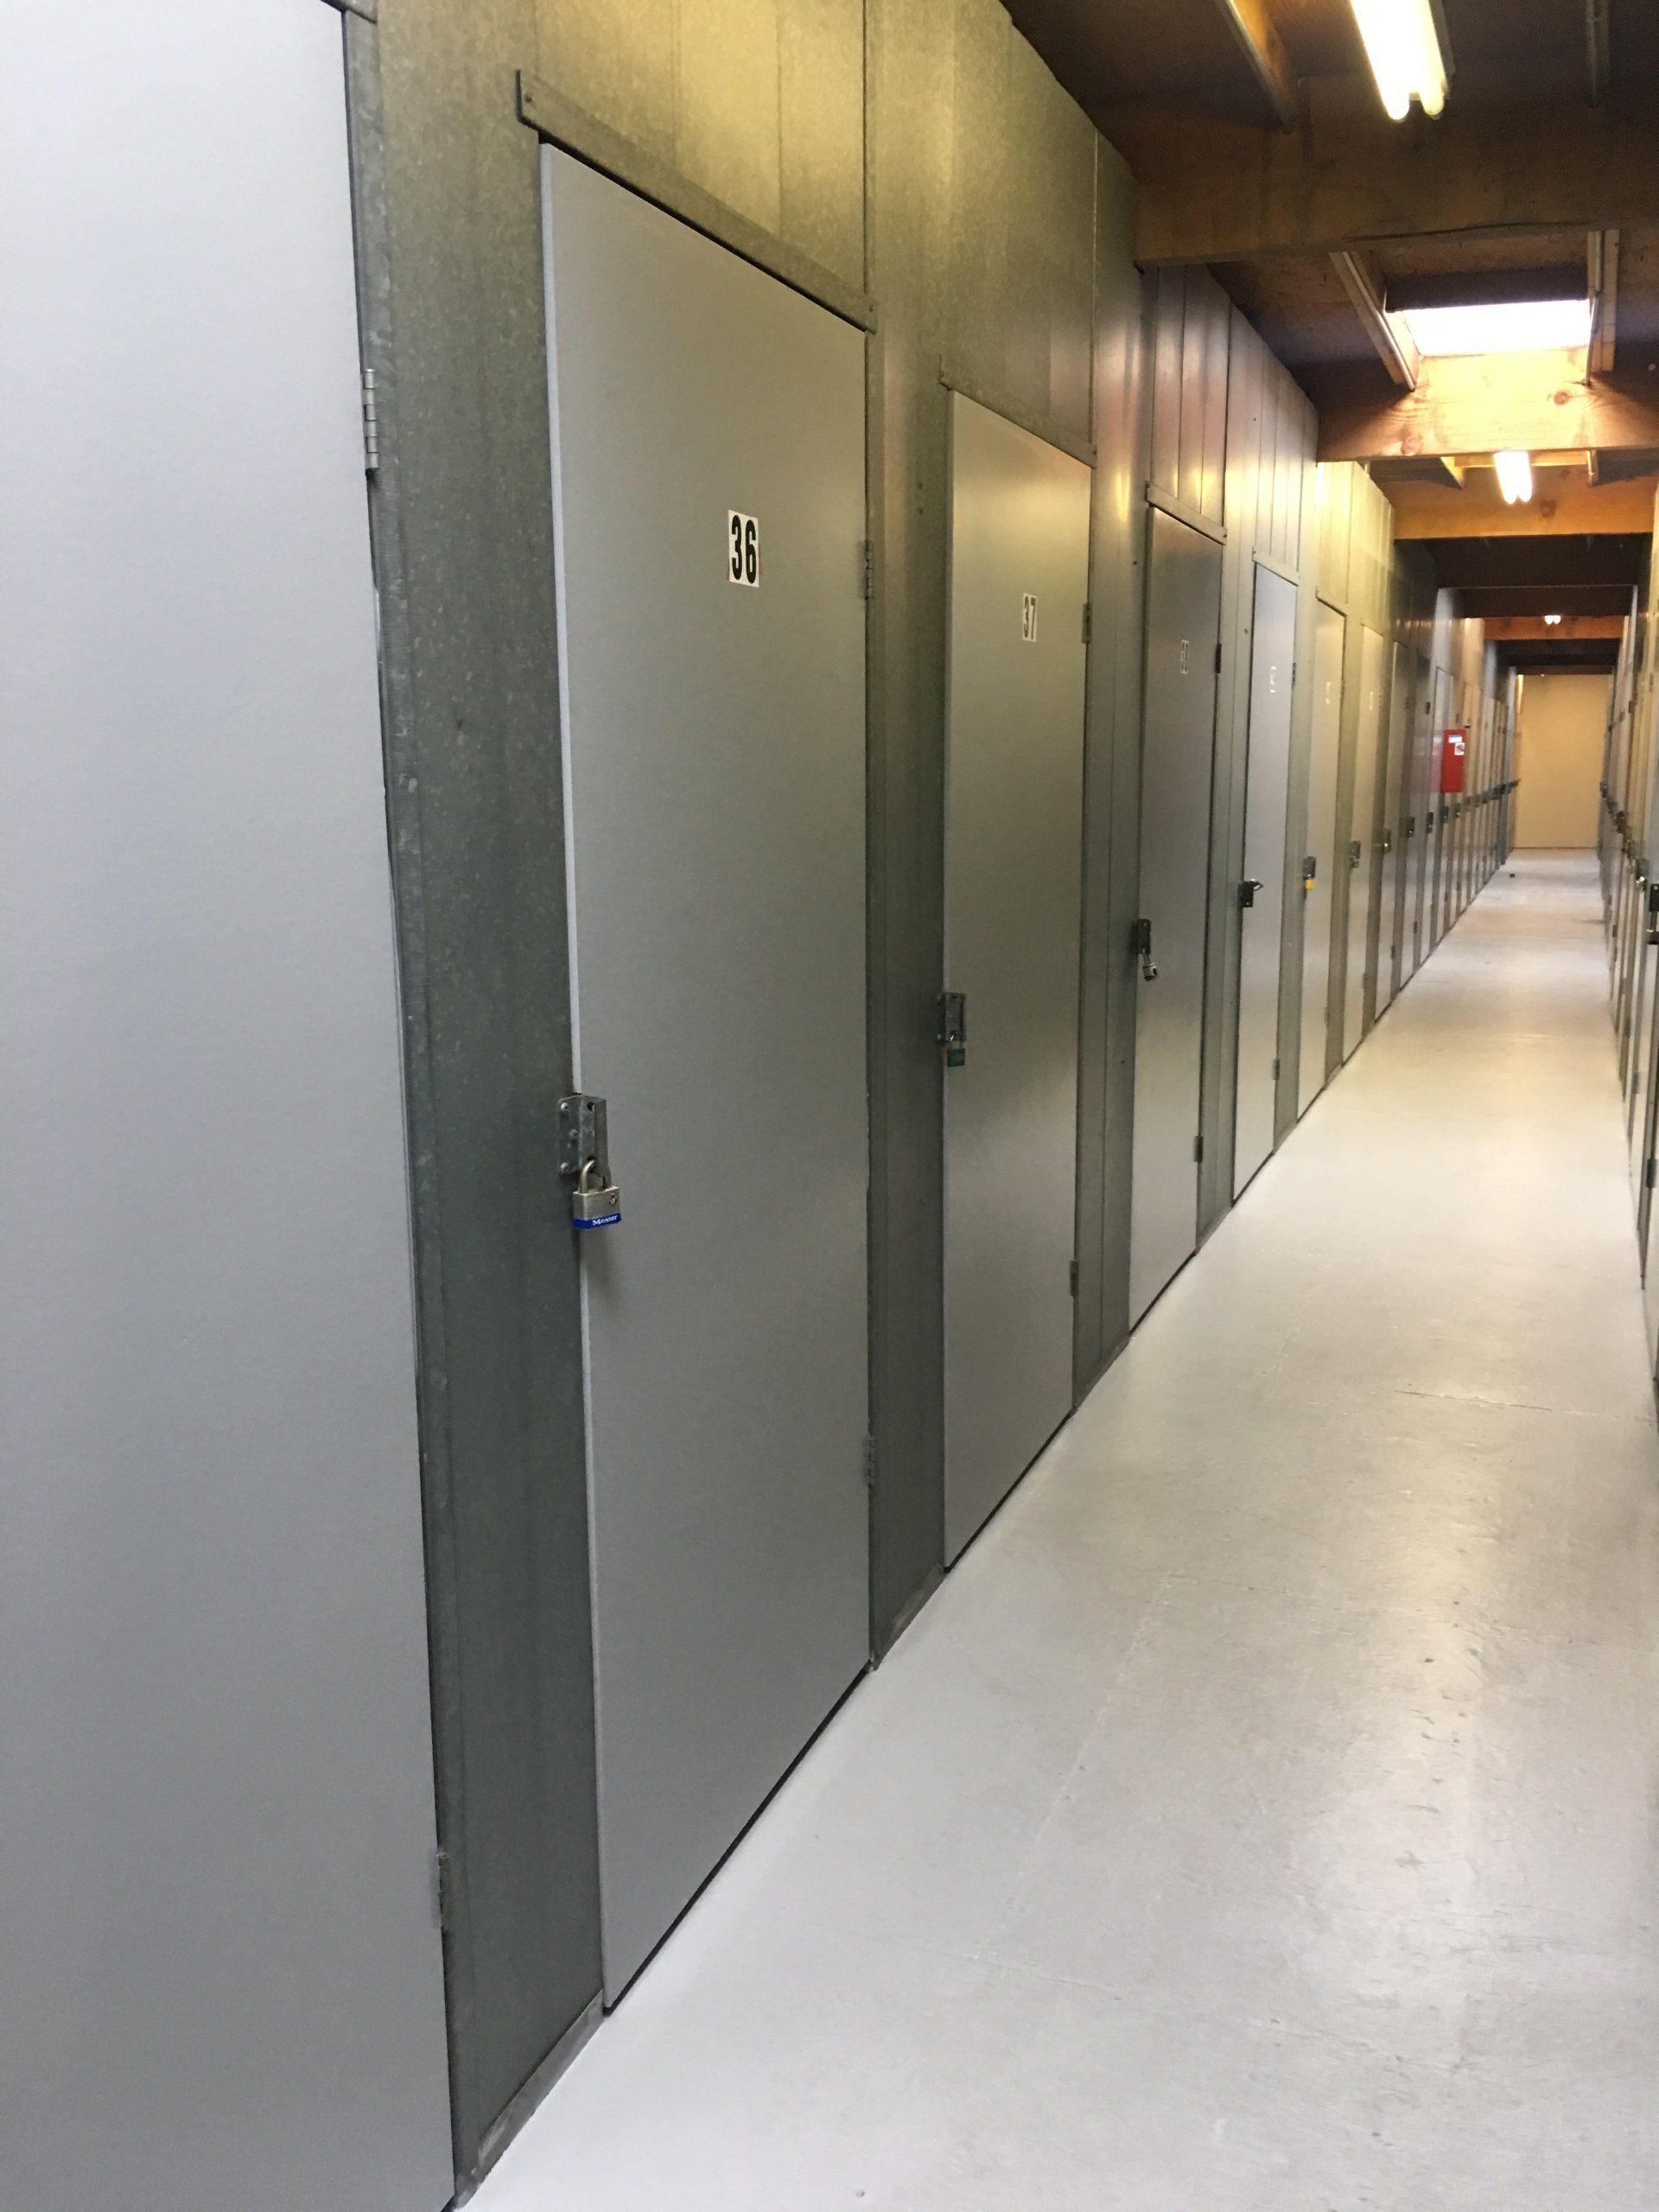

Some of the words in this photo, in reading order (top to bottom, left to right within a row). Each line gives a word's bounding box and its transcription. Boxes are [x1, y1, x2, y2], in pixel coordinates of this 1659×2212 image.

[731, 514, 758, 584] 36
[1023, 595, 1037, 640] 37
[592, 1215, 618, 1226] Master
